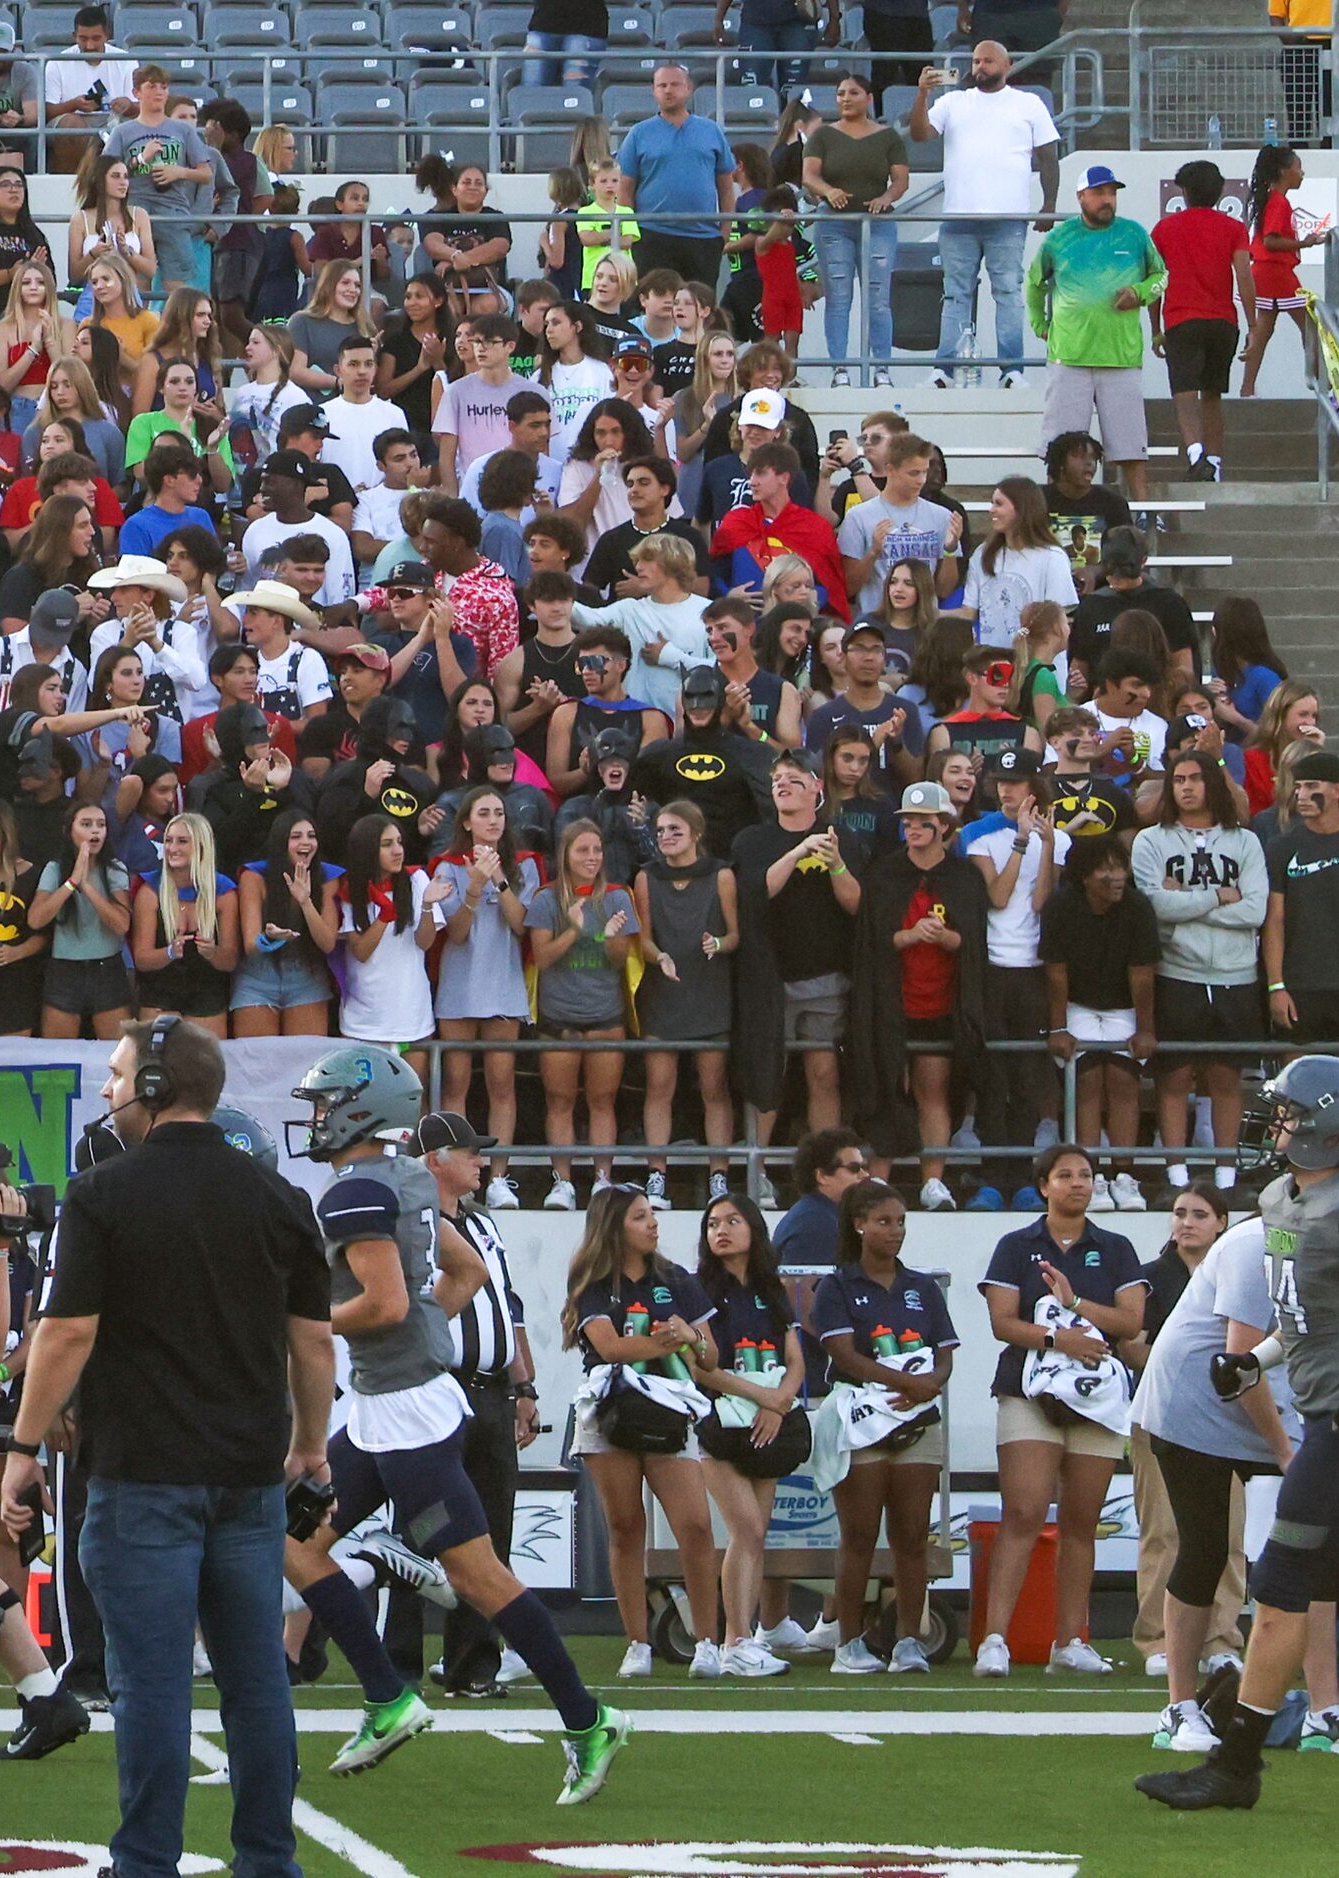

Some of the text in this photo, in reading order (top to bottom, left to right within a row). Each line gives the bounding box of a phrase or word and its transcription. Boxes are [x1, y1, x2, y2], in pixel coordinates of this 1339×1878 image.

[130, 144, 180, 161] EAON
[1164, 195, 1244, 220] 23
[467, 404, 508, 417] Hurley
[1164, 852, 1241, 888] GAP
[772, 1496, 829, 1511] TERBOY
